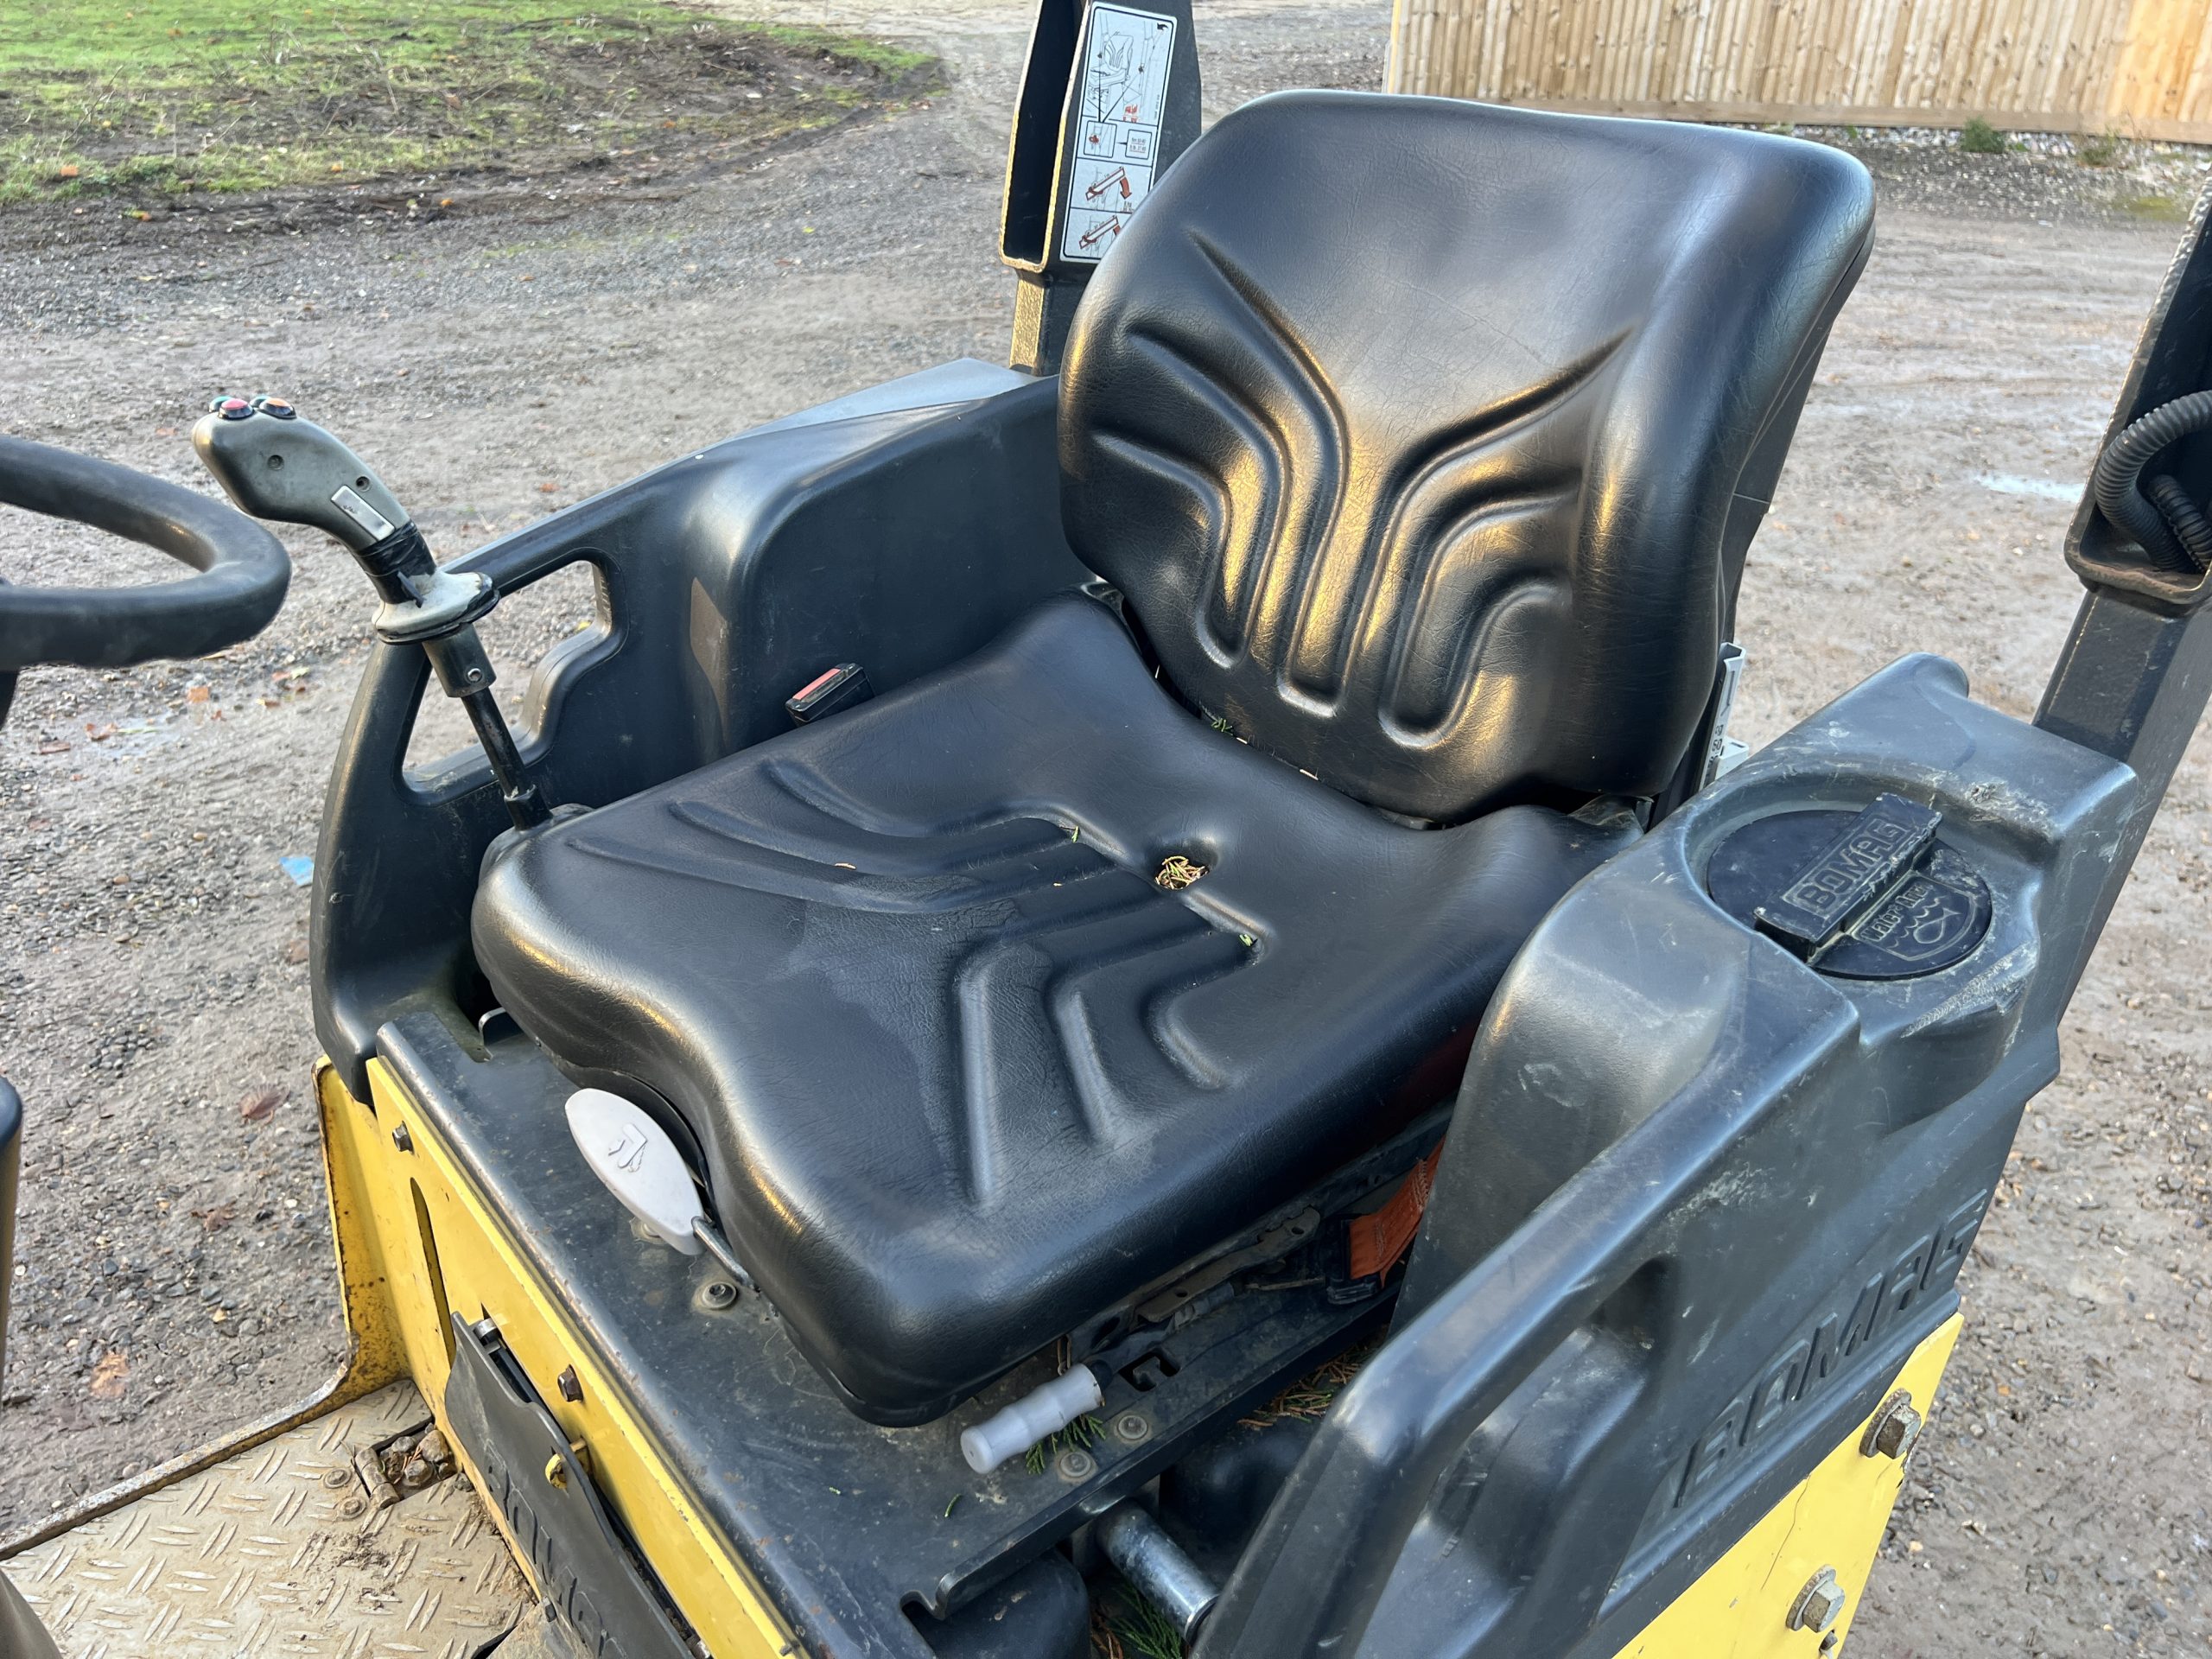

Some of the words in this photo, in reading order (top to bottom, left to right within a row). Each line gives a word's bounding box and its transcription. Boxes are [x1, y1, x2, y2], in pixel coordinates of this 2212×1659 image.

[1796, 817, 1912, 912] BOMAG
[1859, 906, 1904, 943] Water
[1673, 1187, 1987, 1510] BOMAG
